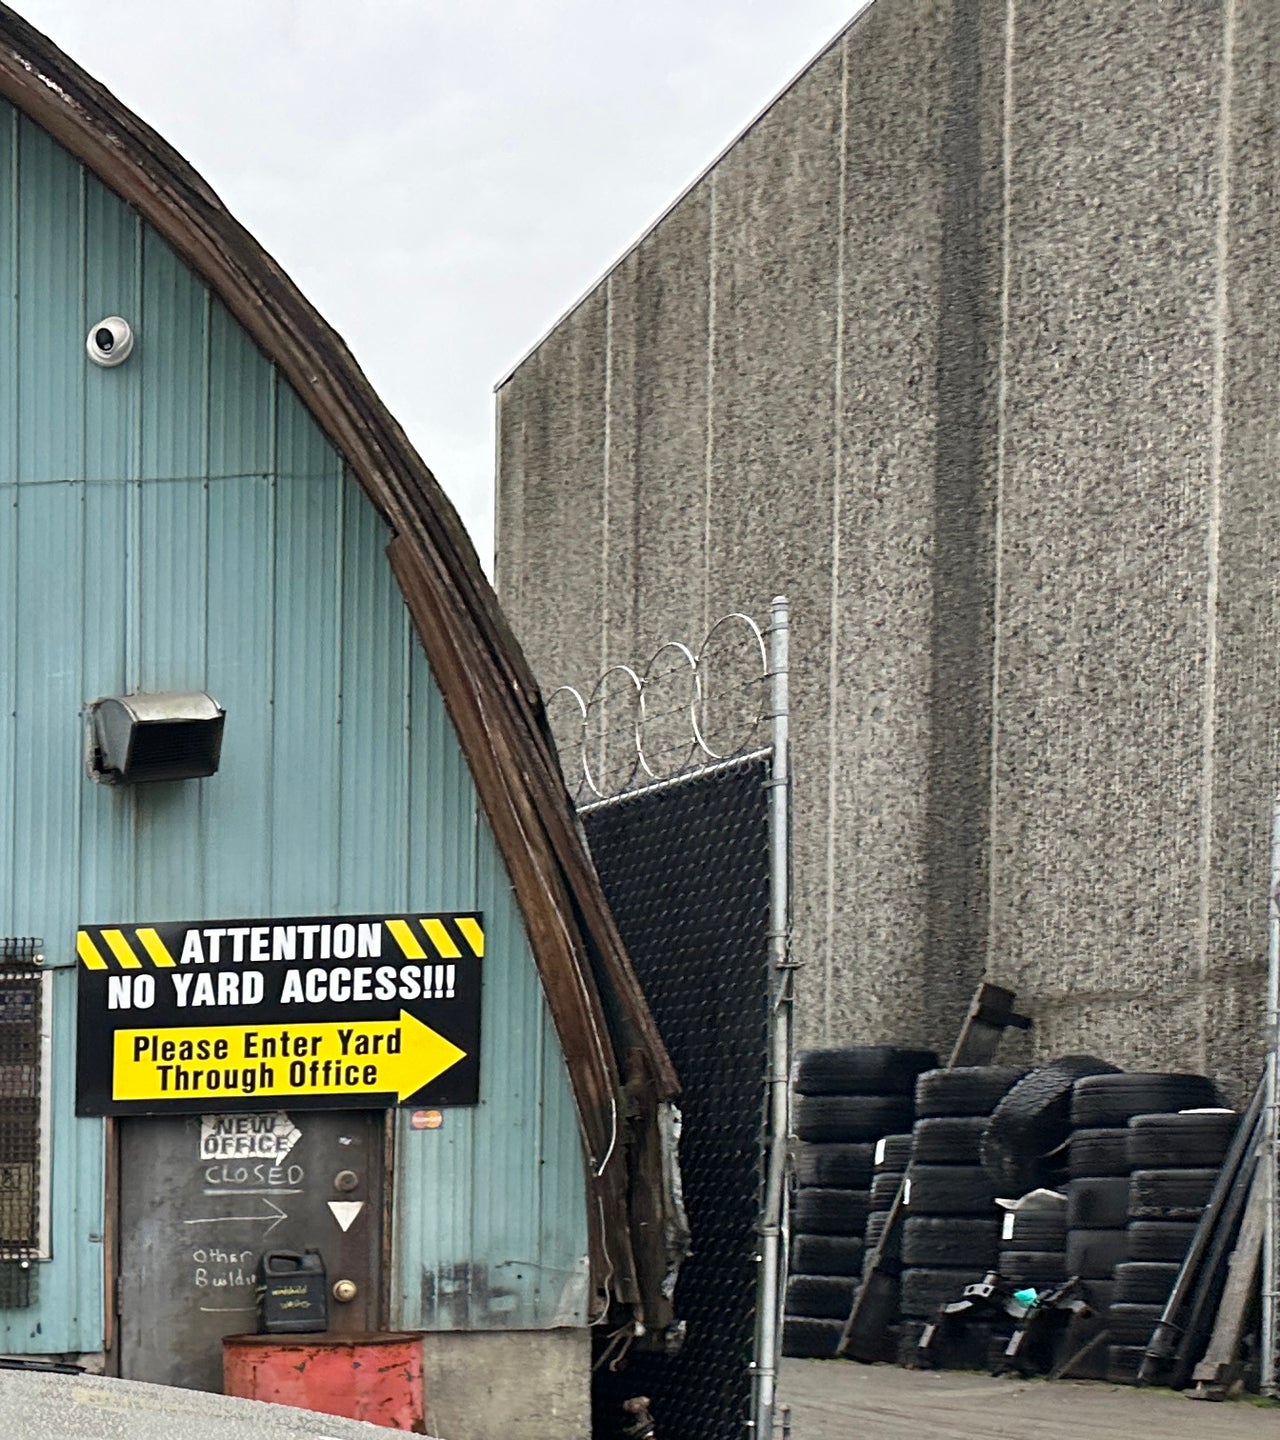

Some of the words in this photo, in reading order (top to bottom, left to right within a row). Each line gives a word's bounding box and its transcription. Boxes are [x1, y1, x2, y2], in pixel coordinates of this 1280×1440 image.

[180, 923, 382, 965] ATTENTION
[107, 973, 156, 1010] NO
[171, 970, 264, 1008] YARD
[280, 964, 455, 1004] ACCESS!!!
[133, 1035, 229, 1063] Please
[244, 1030, 322, 1059] Enter
[337, 1027, 402, 1056] Yard
[156, 1062, 274, 1094] Through
[290, 1060, 378, 1088] Office
[215, 1116, 277, 1134] NEW
[203, 1135, 289, 1154] OFFICE
[204, 1163, 304, 1185] CLOSED
[192, 1248, 253, 1264] Other
